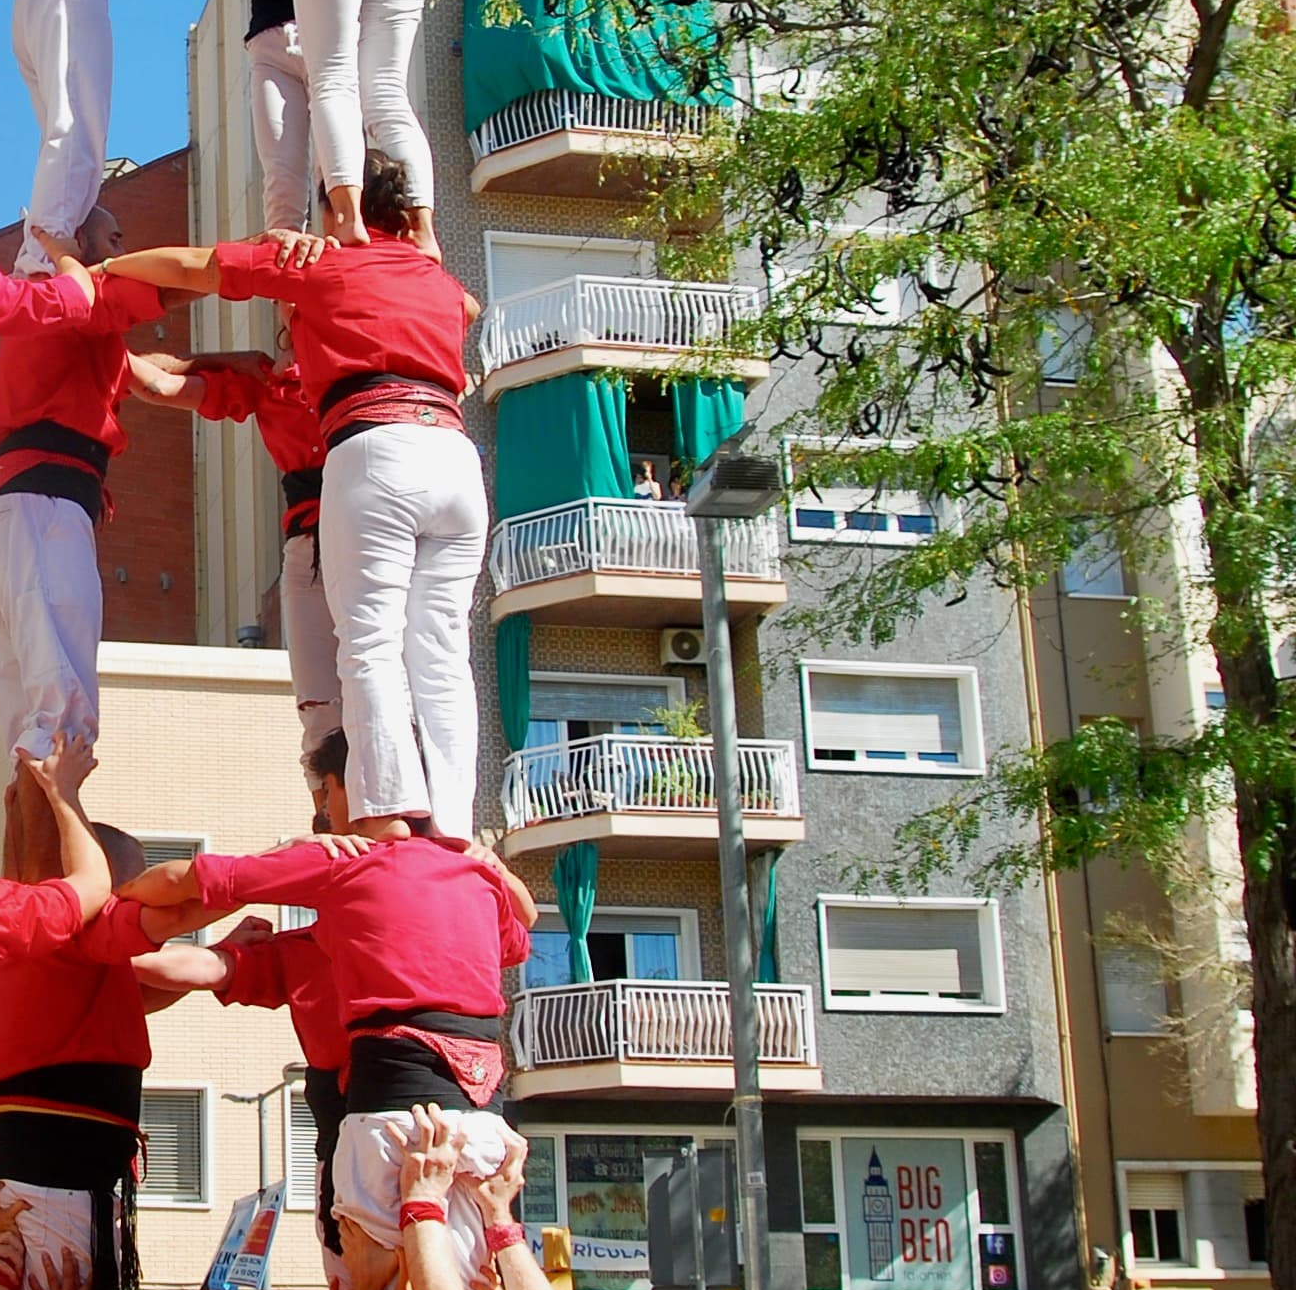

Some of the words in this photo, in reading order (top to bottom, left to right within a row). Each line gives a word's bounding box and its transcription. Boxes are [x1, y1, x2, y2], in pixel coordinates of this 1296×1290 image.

[897, 1165, 942, 1210] BIG
[532, 1238, 647, 1259] MRÍCULA
[900, 1218, 952, 1263] BEN
